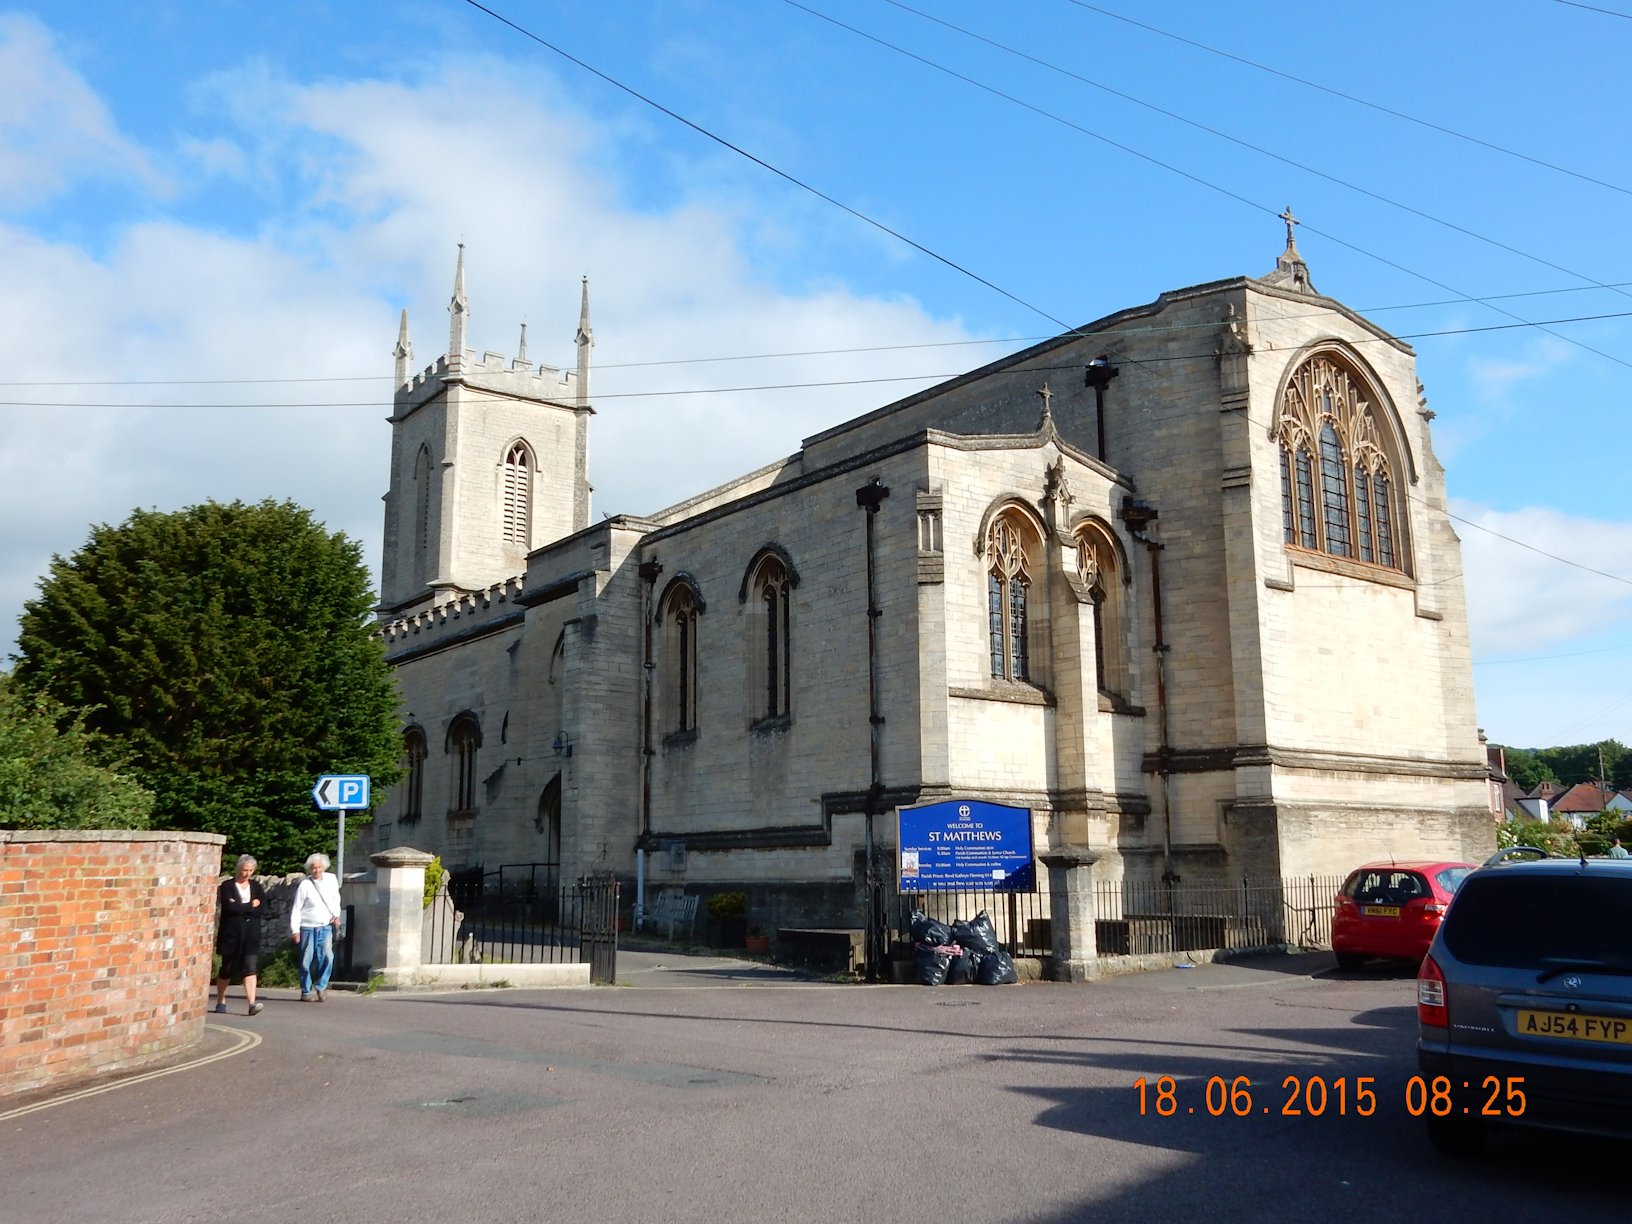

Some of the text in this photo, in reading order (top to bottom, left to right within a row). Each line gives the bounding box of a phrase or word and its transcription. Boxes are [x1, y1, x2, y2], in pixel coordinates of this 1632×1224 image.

[343, 782, 359, 802] P
[928, 831, 1002, 842] ST MATTHEWS
[1526, 1014, 1627, 1040] AJ54 FYP
